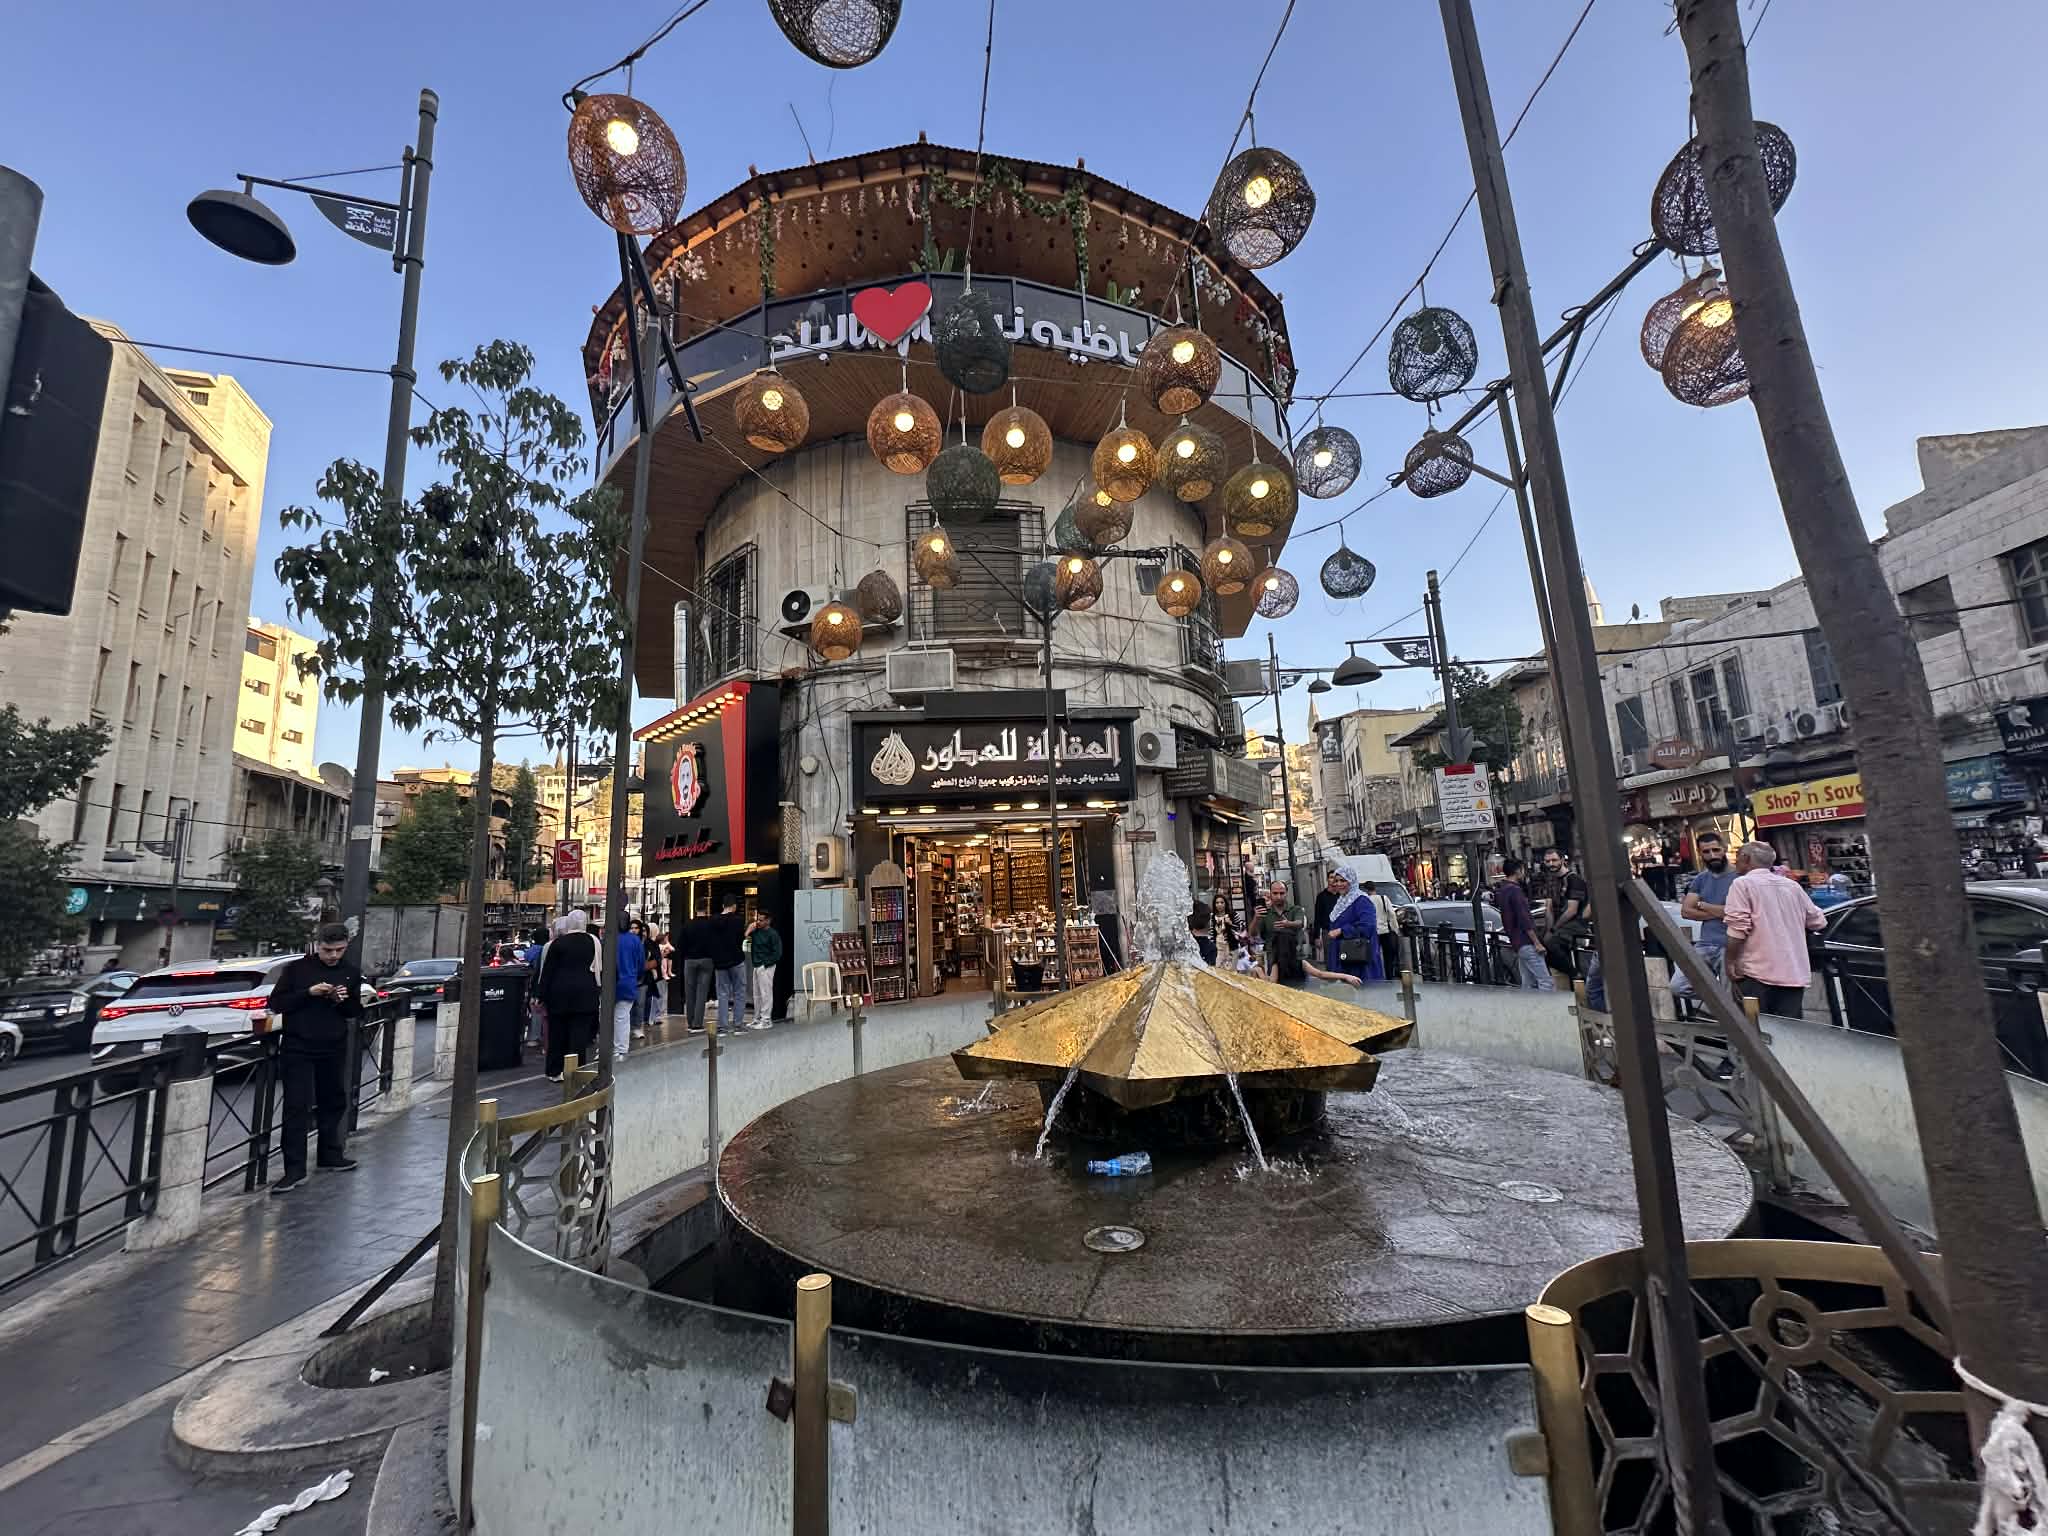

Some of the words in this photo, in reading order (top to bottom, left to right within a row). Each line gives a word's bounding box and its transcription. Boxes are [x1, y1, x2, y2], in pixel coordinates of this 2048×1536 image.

[921, 727, 1018, 771] للعطور
[1024, 725, 1122, 767] العقابلة
[1656, 746, 1676, 757] الله
[1679, 745, 1696, 757] رام
[930, 777, 957, 789] العطور
[1663, 786, 1686, 805] الله
[1688, 784, 1706, 805] رام
[1807, 792, 1819, 805] n
[1794, 807, 1839, 821] OUTLET
